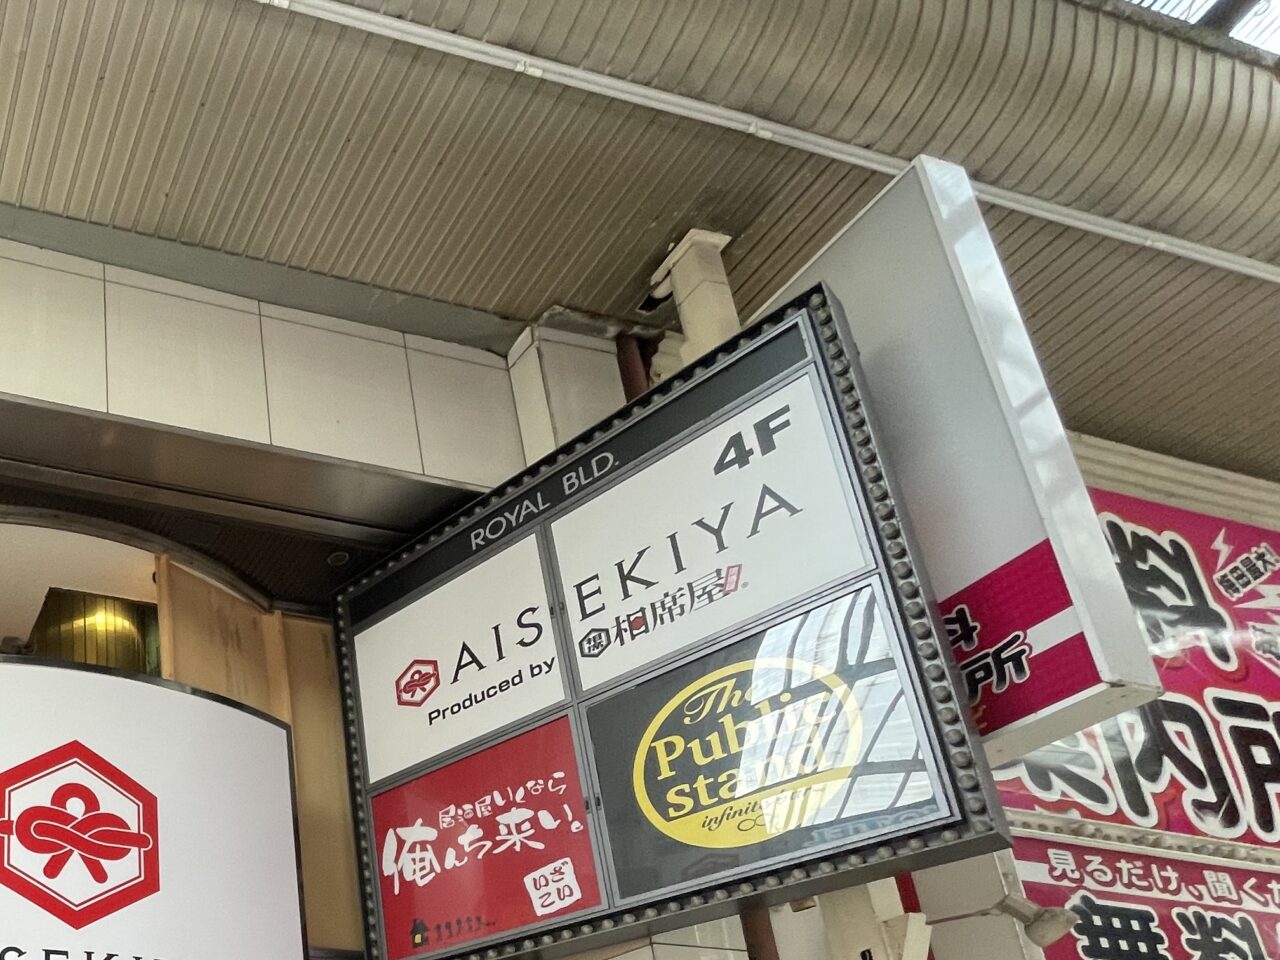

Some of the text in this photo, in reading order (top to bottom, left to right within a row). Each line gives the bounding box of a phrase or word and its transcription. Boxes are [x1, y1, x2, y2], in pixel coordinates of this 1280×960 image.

[712, 404, 792, 476] 4F
[469, 450, 620, 551] ROYAL BLD.
[426, 656, 556, 727] Produced by
